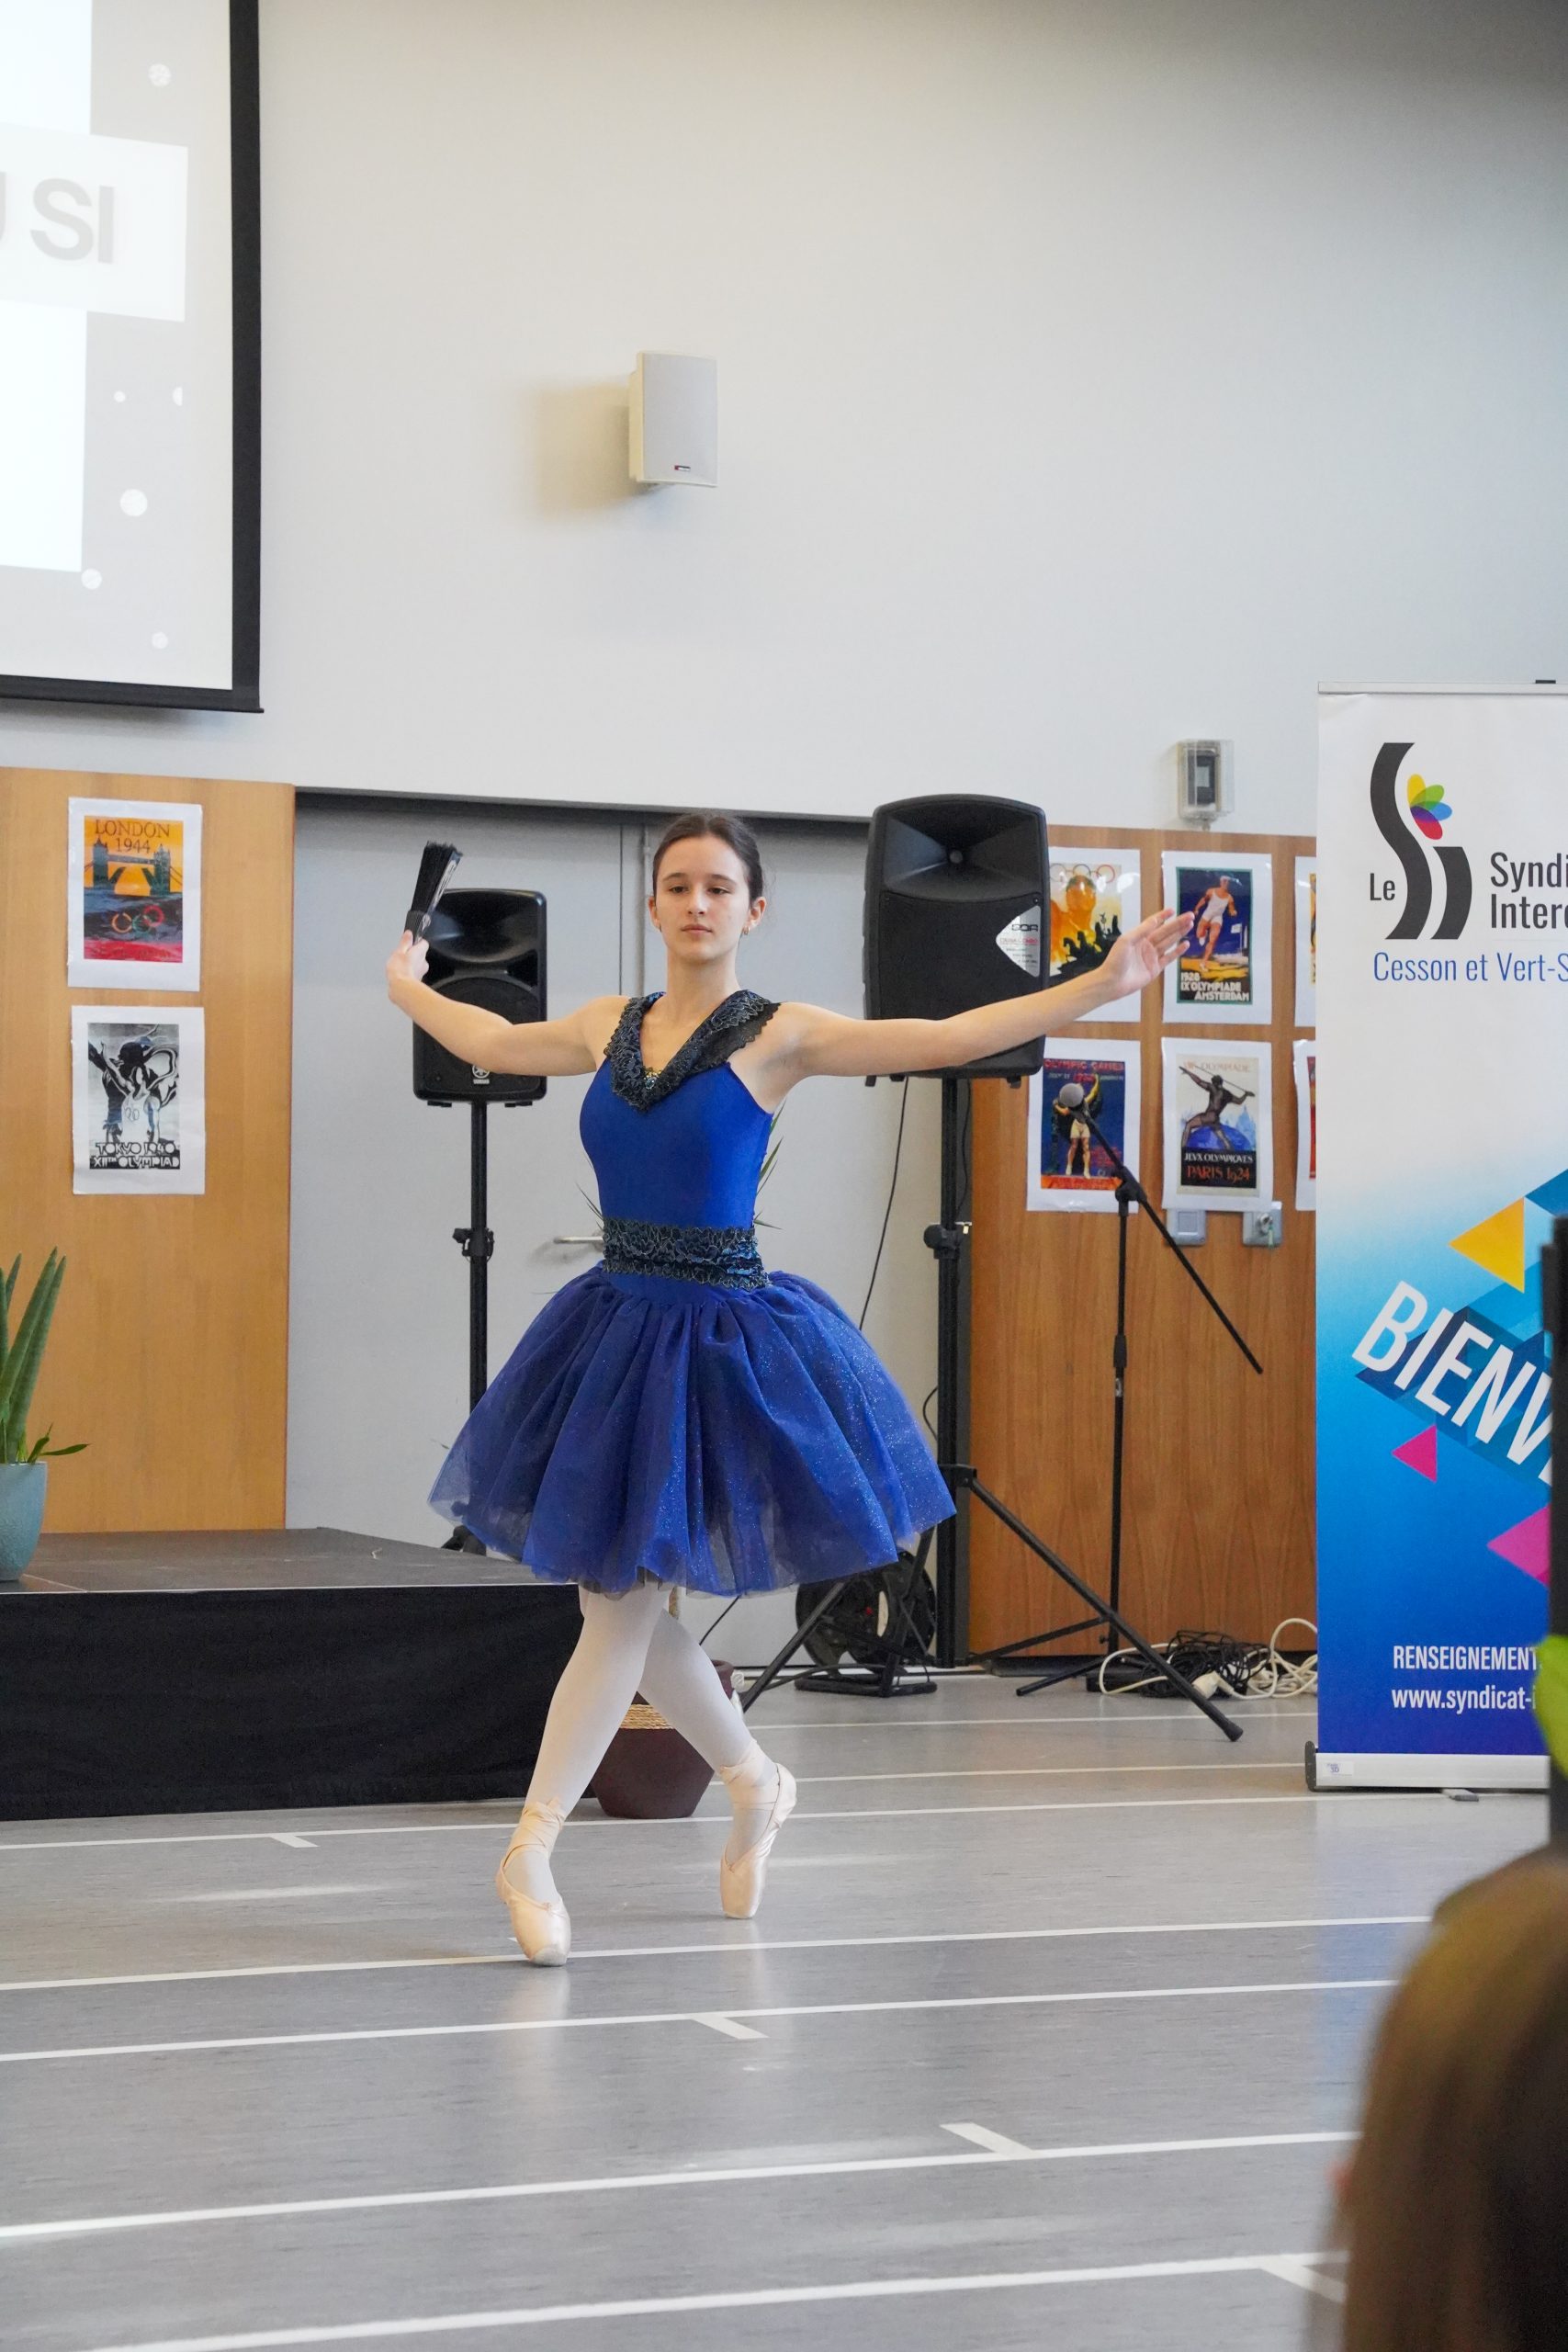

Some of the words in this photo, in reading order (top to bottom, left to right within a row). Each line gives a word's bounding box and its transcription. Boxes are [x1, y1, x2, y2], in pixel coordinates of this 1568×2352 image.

[29, 177, 115, 264] SI
[95, 820, 170, 838] LONDON
[115, 837, 151, 854] 1944
[1370, 872, 1396, 901] Le
[1491, 893, 1568, 929] Inter
[1373, 951, 1458, 982] Cesson
[1465, 953, 1488, 982] et
[1496, 952, 1568, 983] Vert-S
[1180, 972, 1201, 982] 1928
[1190, 981, 1242, 992] OLYMPIADE
[1194, 991, 1250, 1001] AMSTERDAM
[96, 1142, 141, 1156] TOKYO
[143, 1142, 177, 1156] 1940
[118, 1156, 181, 1169] OLYMPIAD
[1187, 1165, 1224, 1179] PARIS
[1226, 1167, 1250, 1183] 1924
[1351, 1280, 1552, 1487] BIENV
[1393, 1645, 1542, 1670] RENSEIGNEMENT
